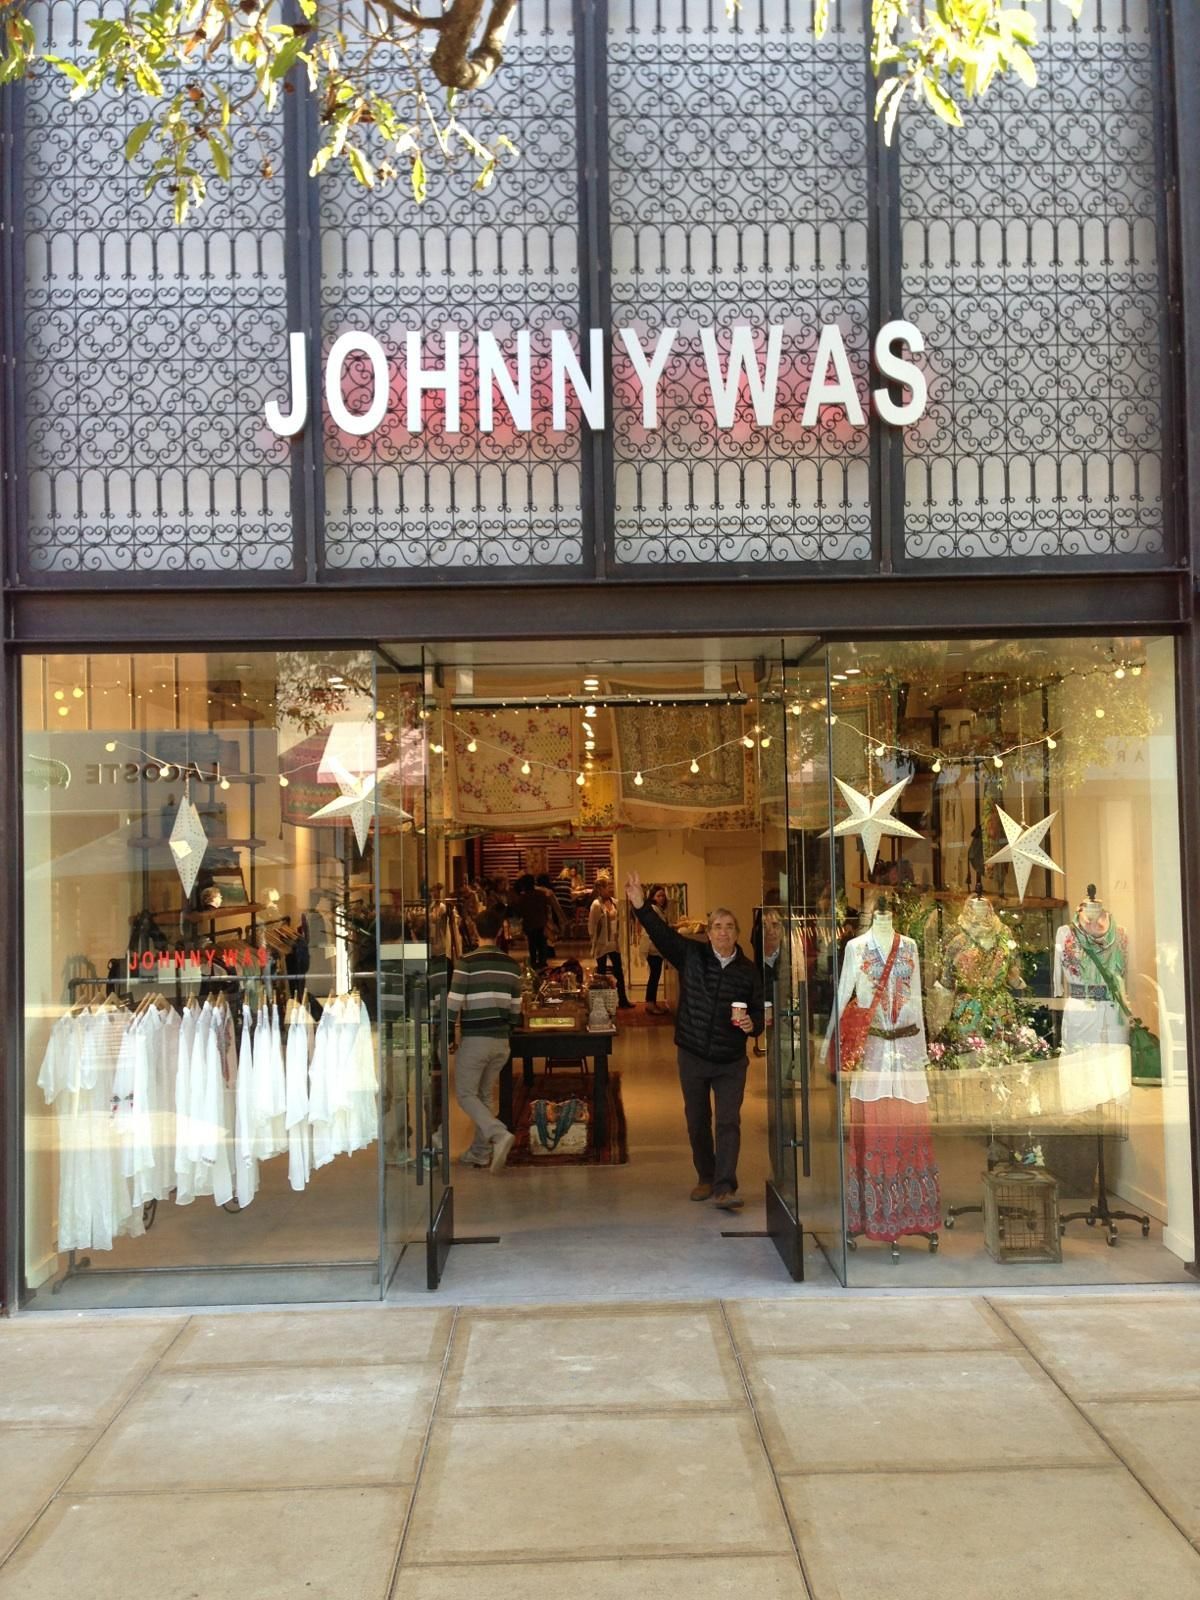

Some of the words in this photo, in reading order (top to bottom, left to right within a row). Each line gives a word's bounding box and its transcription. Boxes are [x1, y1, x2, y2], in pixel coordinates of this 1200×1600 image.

[263, 326, 679, 437] JOHNNY
[699, 319, 929, 429] WAS
[129, 949, 216, 971] JOHNNY
[223, 944, 268, 968] WAS
